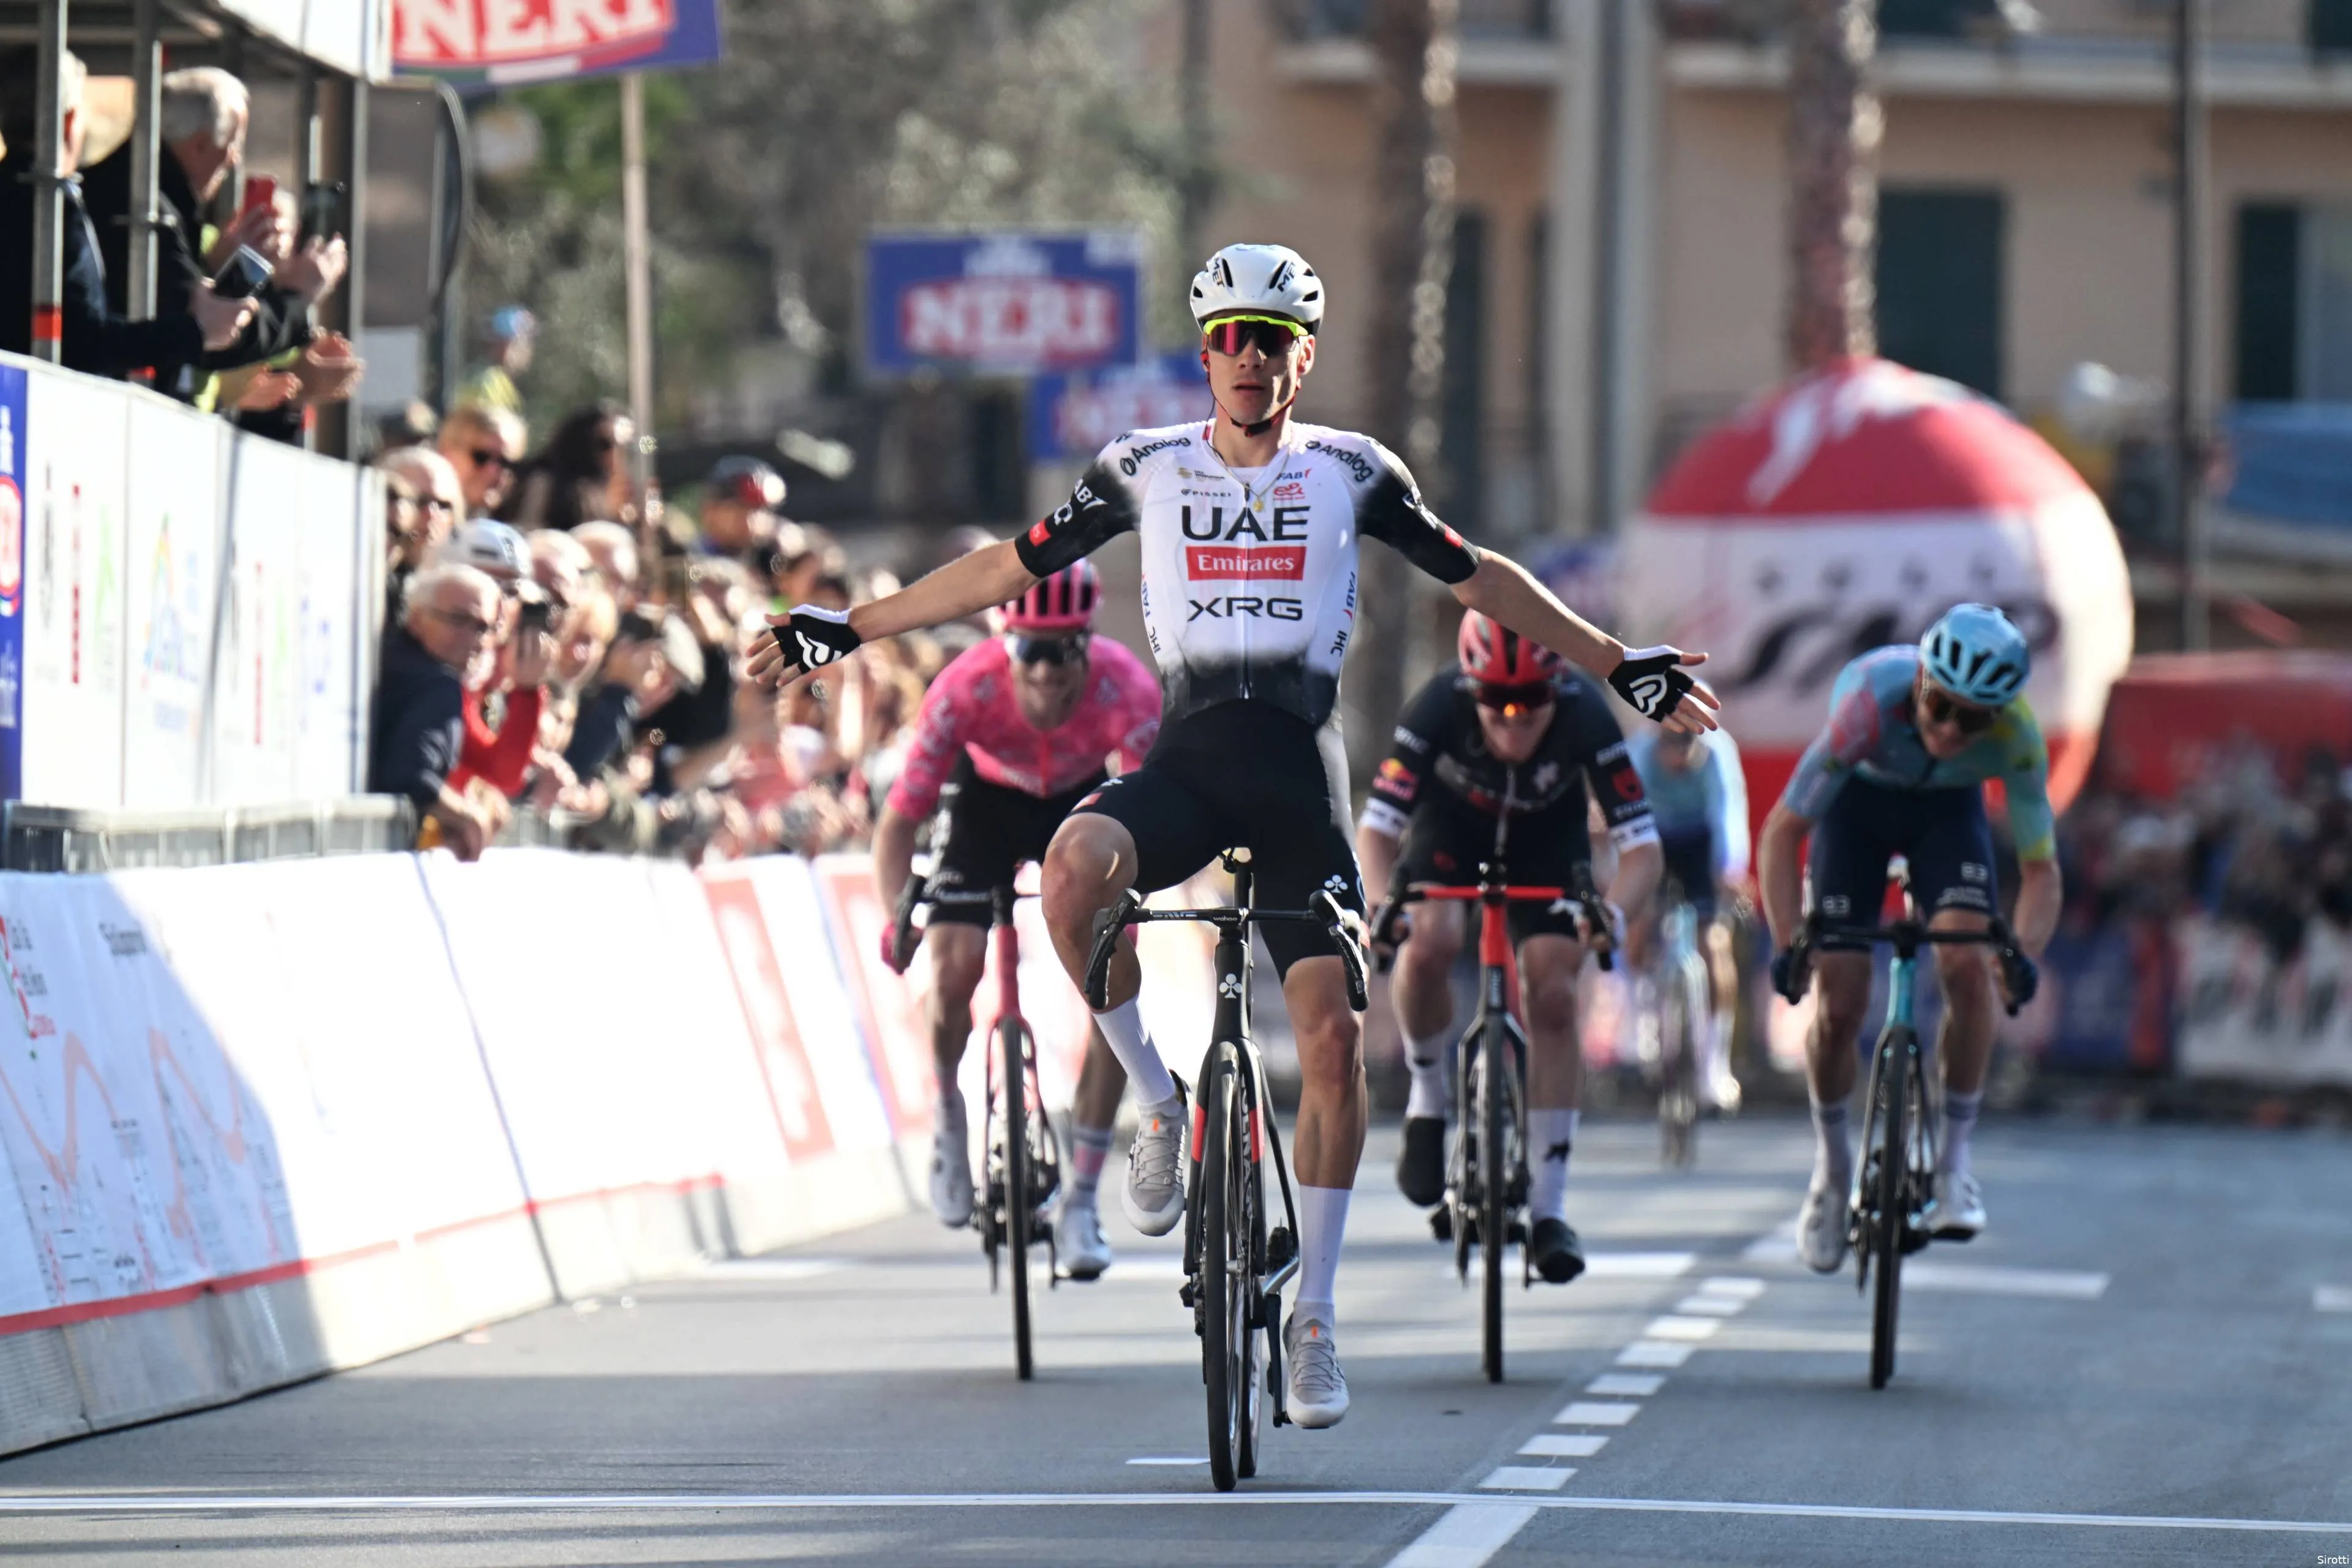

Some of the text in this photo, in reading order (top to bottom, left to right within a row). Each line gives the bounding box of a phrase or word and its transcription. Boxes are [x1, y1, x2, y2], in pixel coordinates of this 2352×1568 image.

[1212, 257, 1225, 288] MET
[1277, 261, 1295, 293] MET
[1132, 437, 1191, 464] Analog
[1318, 444, 1374, 482] Analog
[1276, 472, 1303, 480] FAB
[1182, 505, 1311, 541] UAE
[1197, 554, 1295, 571] Emirates
[1346, 570, 1355, 608] FAB
[1187, 597, 1303, 622] XRG
[1148, 626, 1161, 654] IHC
[1330, 630, 1348, 657] IHC
